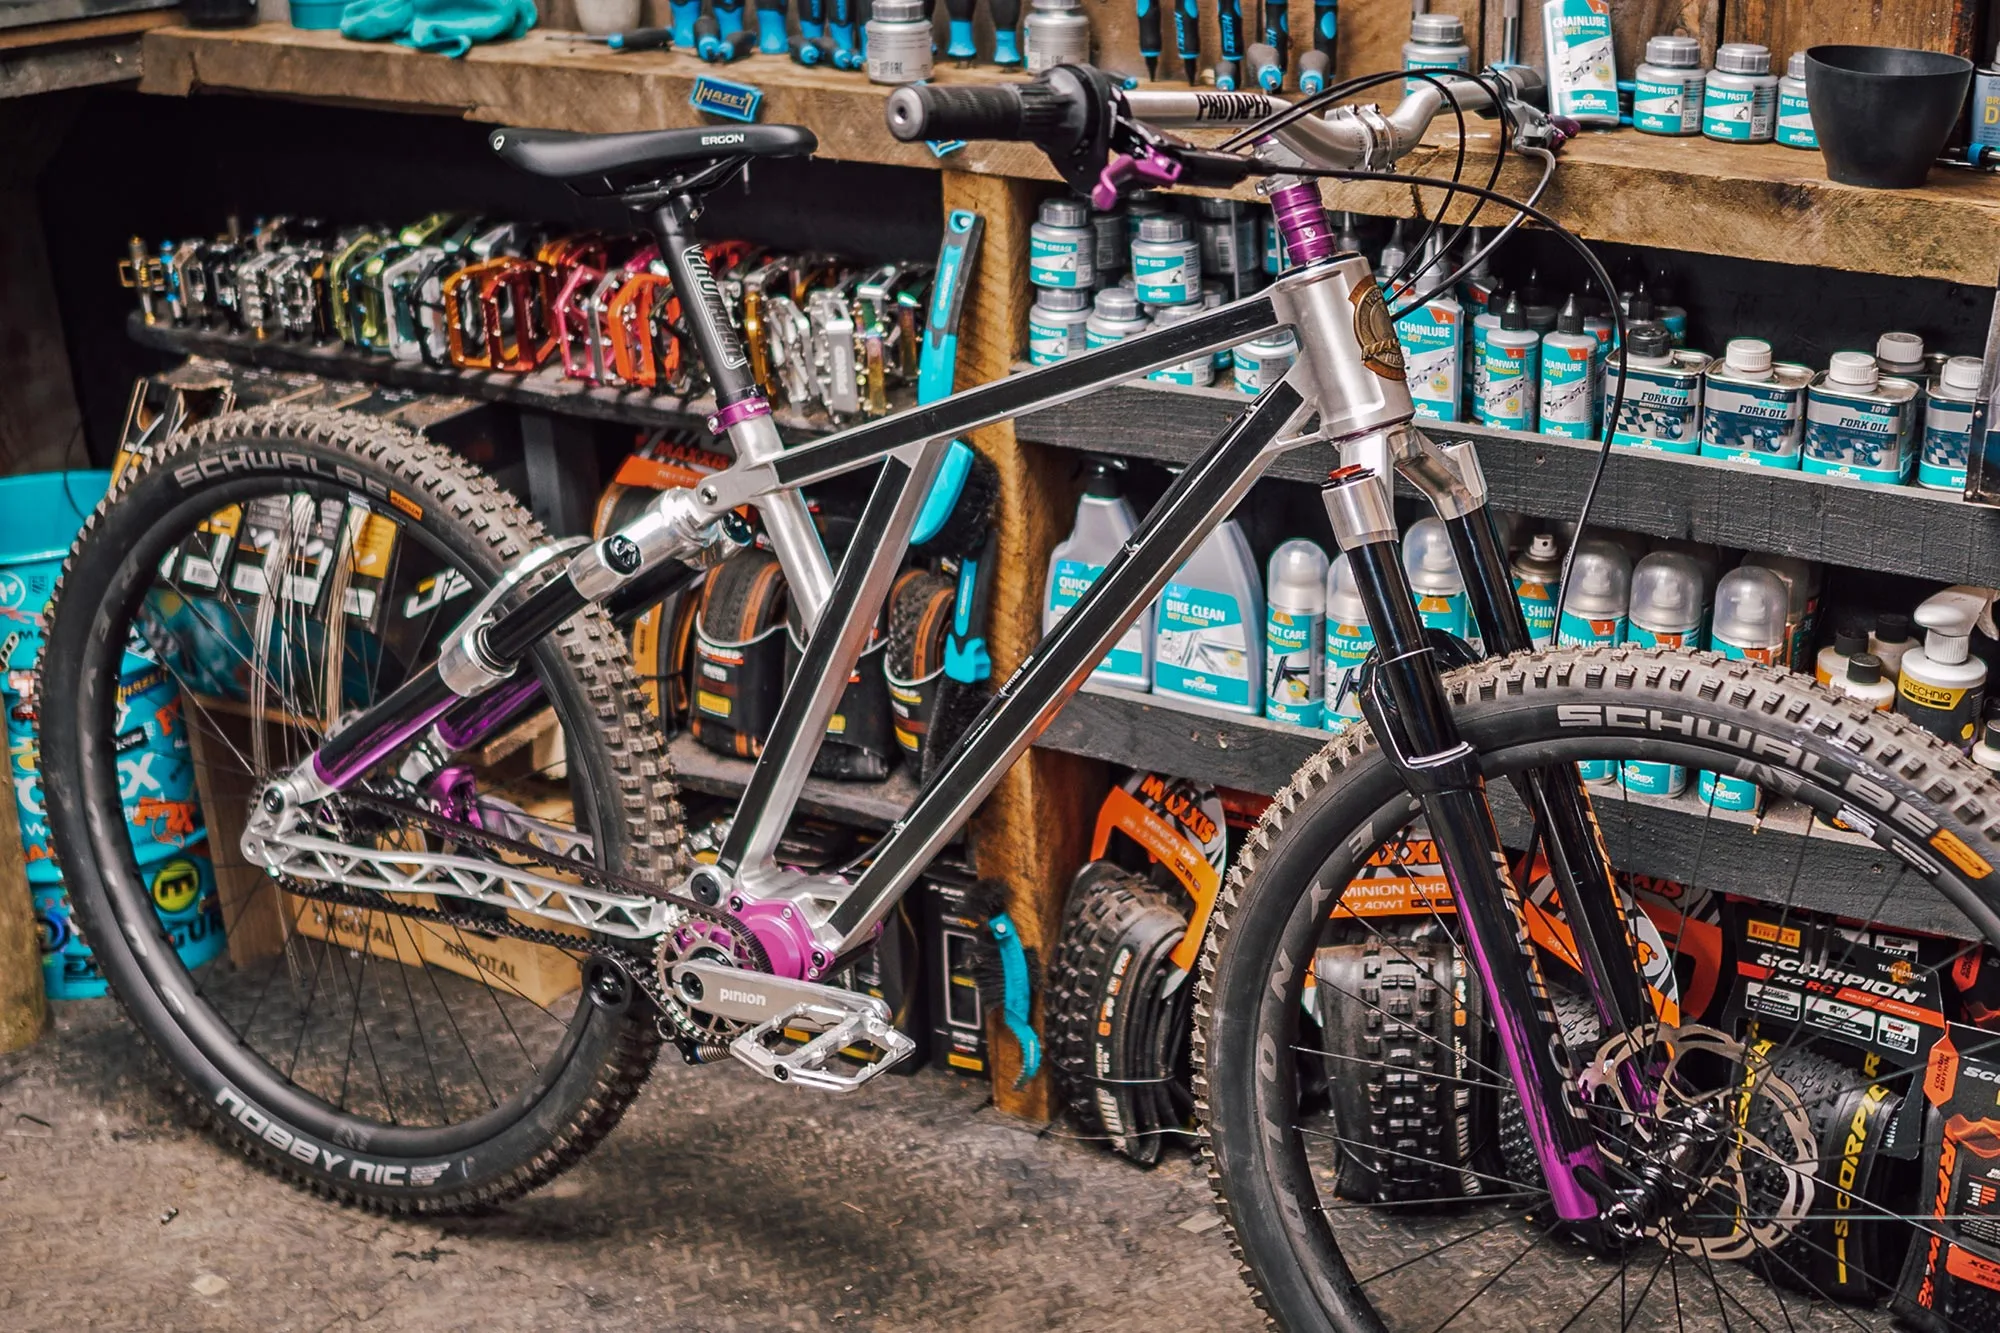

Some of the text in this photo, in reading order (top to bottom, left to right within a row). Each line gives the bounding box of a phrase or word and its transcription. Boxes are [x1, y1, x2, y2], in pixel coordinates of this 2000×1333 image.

[1552, 15, 1607, 27] CHAINLUBE
[1222, 13, 1235, 53] HAZET
[702, 87, 748, 108] HAZET
[1657, 86, 1679, 96] PASTE
[1726, 92, 1748, 102] PASTE
[1195, 93, 1273, 122] PROTAPER
[1782, 97, 1809, 108] BIKE GRE
[701, 133, 745, 146] ERGON
[1399, 320, 1451, 338] CHAINLUBE
[1641, 392, 1689, 406] FORK OIL
[1870, 405, 1891, 414] 10W
[1738, 404, 1787, 419] FORK OIL
[1839, 417, 1889, 433] FORK OIL
[174, 450, 388, 499] SCHWALBE
[1166, 598, 1190, 615] BIKE
[1190, 605, 1226, 623] CLEAN
[1527, 605, 1555, 617] SHIN
[1283, 629, 1307, 640] CARE
[1903, 679, 1952, 701] GTECHNIQ
[1556, 703, 1940, 838] SCHWALBE
[1140, 774, 1217, 844] MAXXIS
[1367, 839, 1441, 867] AXXI
[1343, 882, 1446, 898] MINION DHR
[443, 940, 521, 982] ARGOTAL
[1877, 963, 1896, 976] TEAM
[1490, 850, 1589, 1120] MANITOU
[1756, 952, 1921, 1004] SCORPION
[1773, 973, 1836, 995] XC RC
[719, 987, 767, 1008] pinion
[215, 1086, 407, 1186] NOBBY NIC
